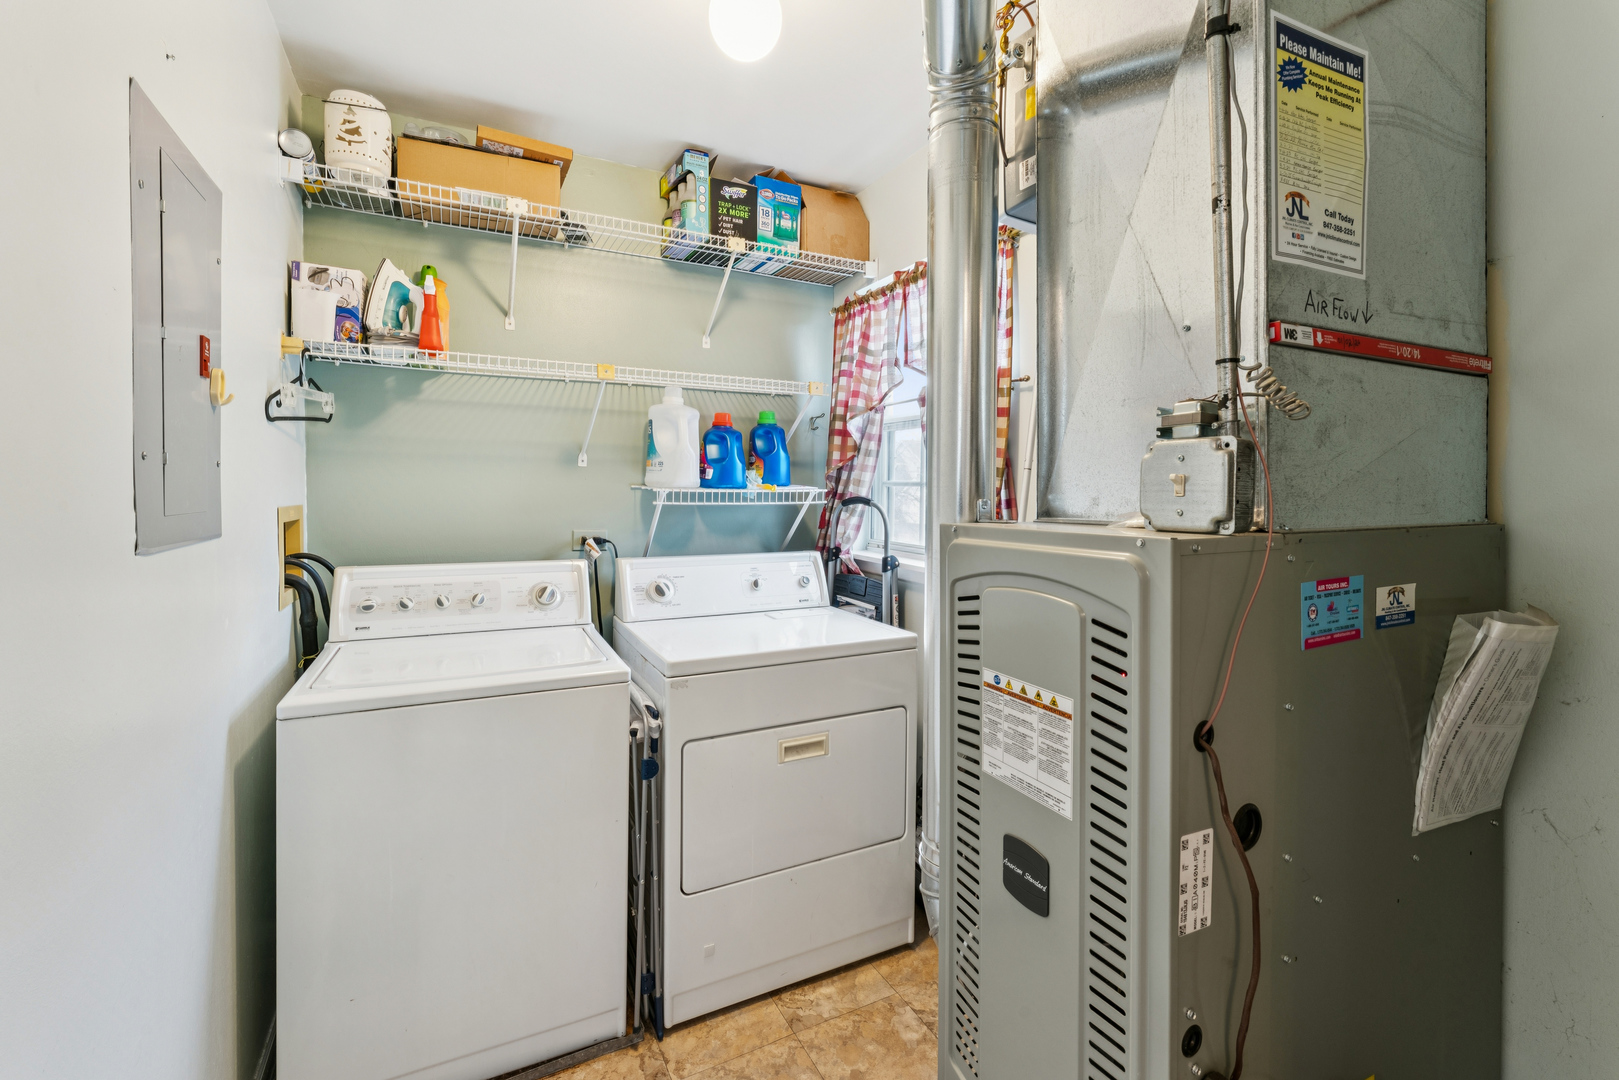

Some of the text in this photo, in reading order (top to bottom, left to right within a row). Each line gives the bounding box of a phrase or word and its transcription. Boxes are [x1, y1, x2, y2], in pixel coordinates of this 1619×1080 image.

[1280, 34, 1360, 78] Please Maintain Me!
[1309, 70, 1360, 94] Annual Maintenance
[1308, 79, 1324, 91] Keeps
[1334, 89, 1354, 103] Running
[1356, 96, 1361, 104] At
[1316, 92, 1354, 112] Peak Efficiency
[720, 186, 746, 198] Swiffer
[761, 208, 770, 218] 18
[1324, 209, 1354, 226] Call Today
[1323, 221, 1355, 236] 847-358-2251
[1304, 290, 1328, 318] AIR
[1284, 327, 1298, 340] 3M
[1469, 356, 1492, 370] Filtrete
[1463, 686, 1484, 720] Conditioners
[1043, 705, 1072, 720] ADVERTENCIA
[1002, 858, 1047, 892] American Standard
